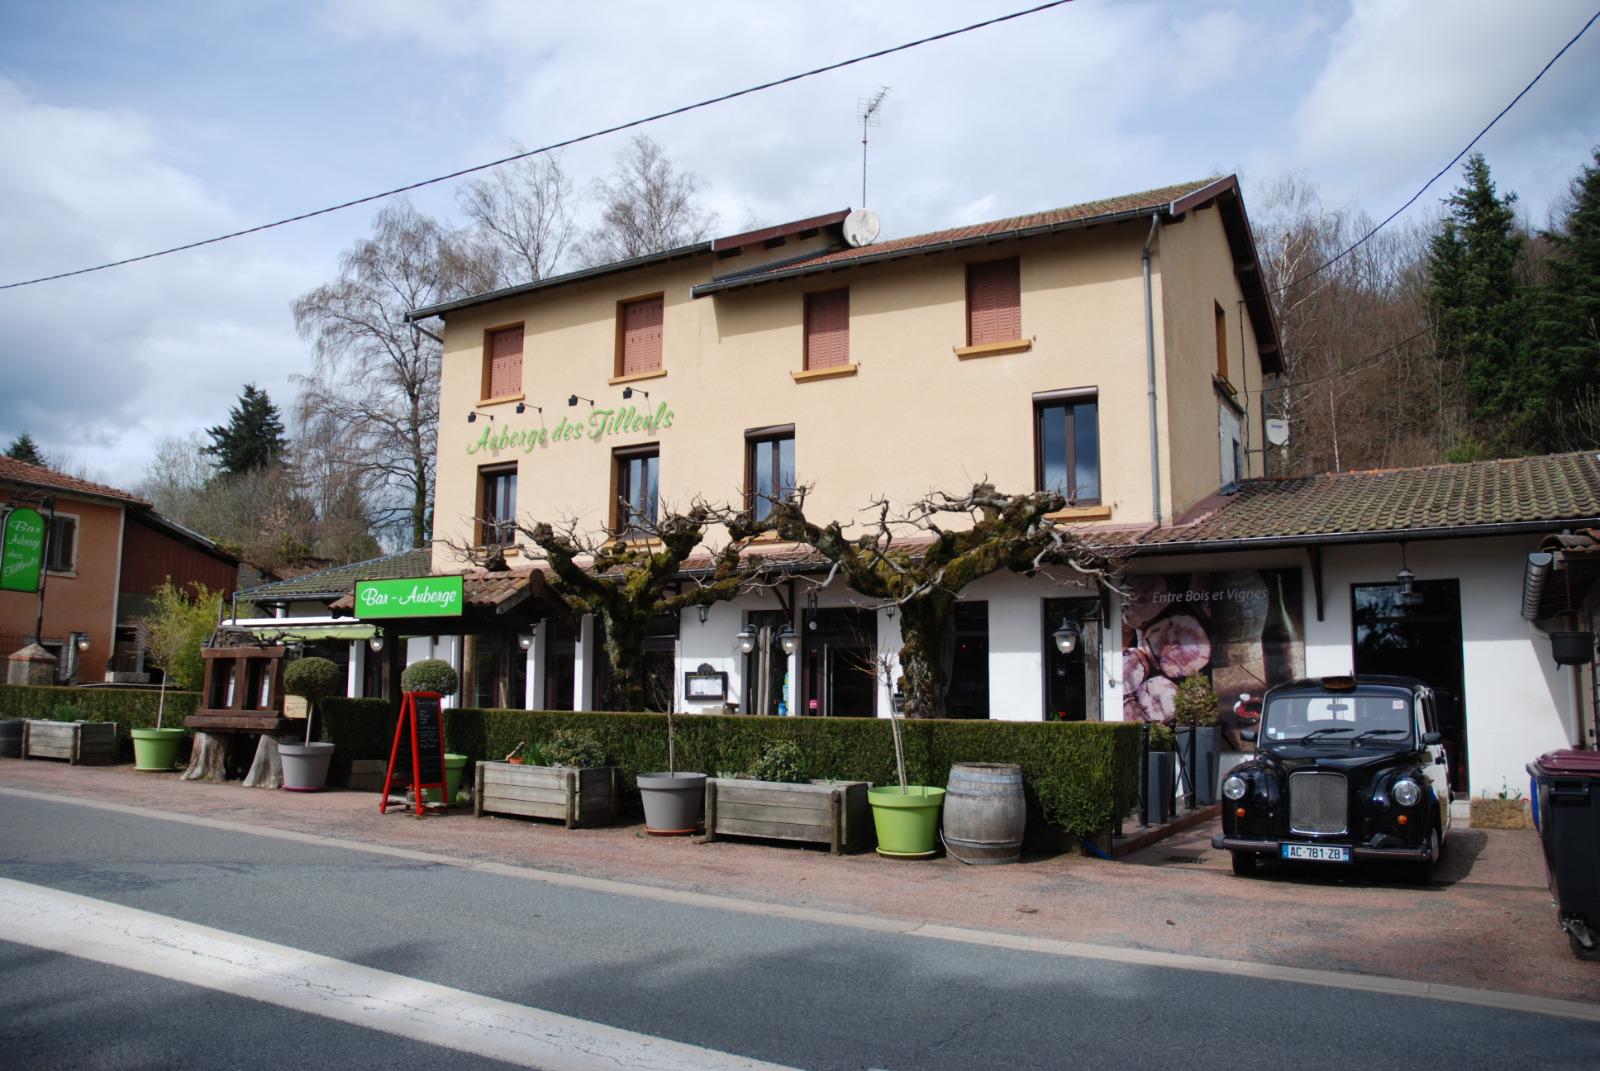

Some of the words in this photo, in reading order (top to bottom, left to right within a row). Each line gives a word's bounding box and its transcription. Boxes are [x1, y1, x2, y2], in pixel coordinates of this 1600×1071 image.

[466, 424, 548, 455] Auberge
[551, 416, 584, 442] des
[587, 400, 675, 439] Tilleuls
[9, 520, 40, 534] Bar
[360, 587, 389, 606] Bar
[398, 585, 457, 608] Auberge
[1152, 591, 1183, 604] Entre
[1185, 590, 1210, 602] Bois
[1212, 589, 1224, 600] et
[1227, 587, 1268, 603] Vignes
